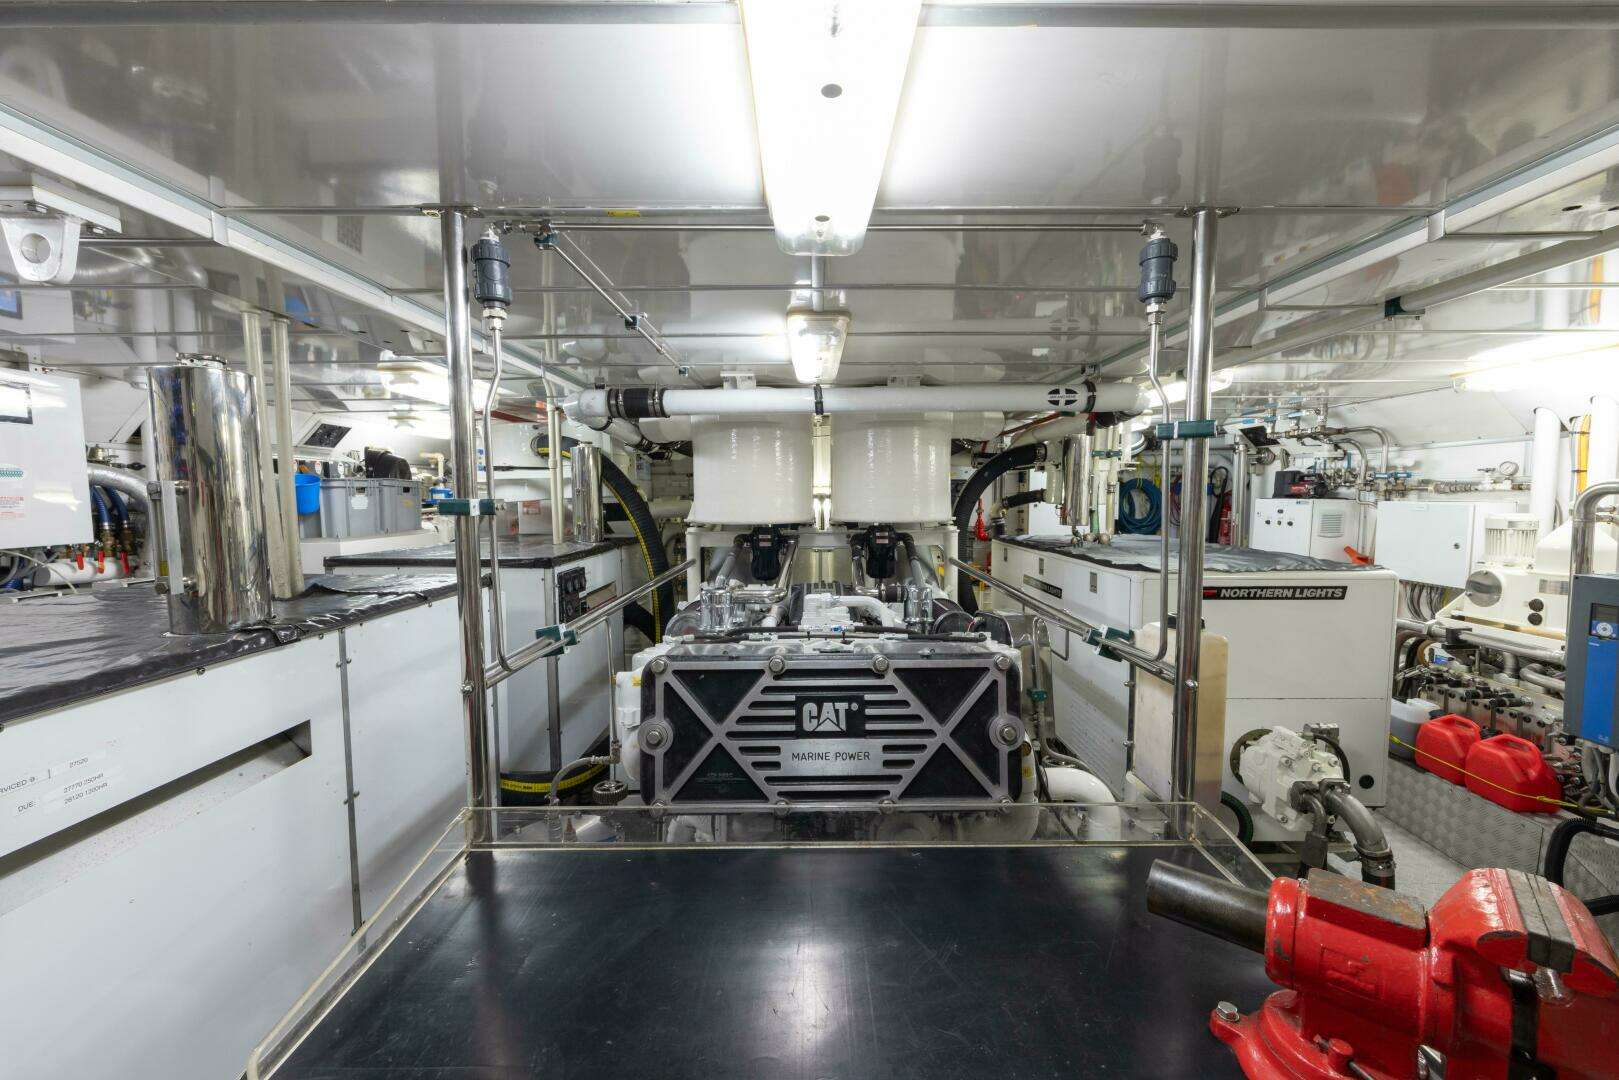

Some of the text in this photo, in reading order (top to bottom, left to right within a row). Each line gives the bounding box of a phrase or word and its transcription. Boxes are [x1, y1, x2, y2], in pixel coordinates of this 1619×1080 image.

[1220, 588, 1343, 598] NORTHERN LIGHTS
[802, 702, 849, 732] CAT
[791, 751, 871, 761] MARINE POWER
